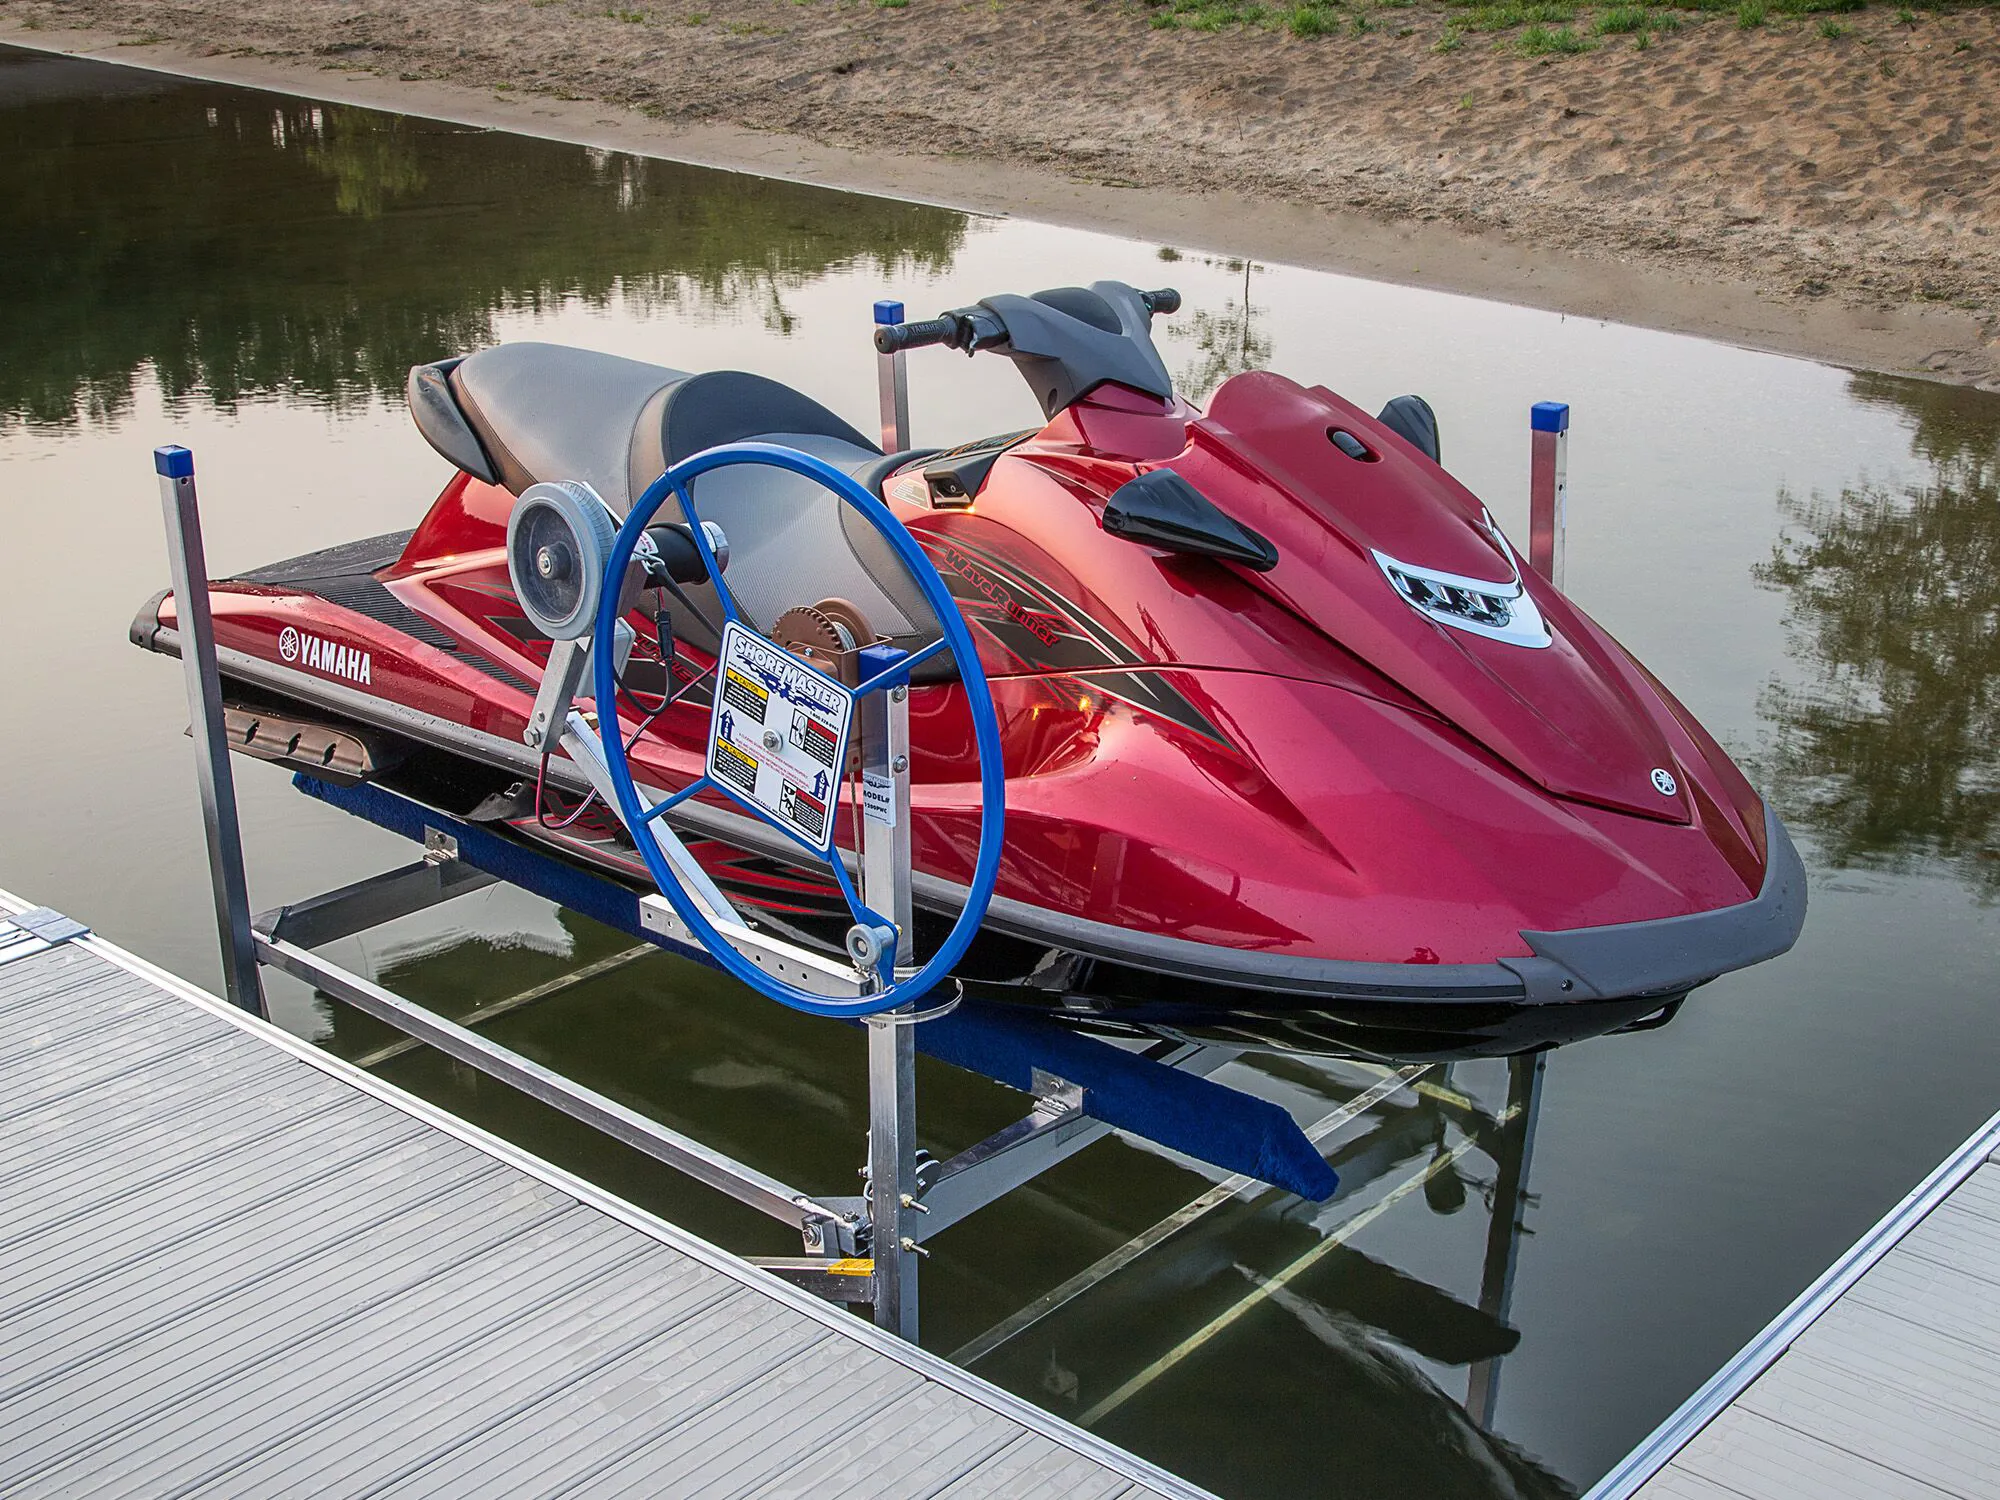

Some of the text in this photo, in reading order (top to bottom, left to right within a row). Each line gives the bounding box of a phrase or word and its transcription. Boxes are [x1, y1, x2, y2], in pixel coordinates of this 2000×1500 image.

[910, 323, 940, 335] YAMAHA
[944, 547, 1059, 647] WaveRunner
[301, 633, 371, 685] YAMAHA
[734, 636, 841, 713] SHOREMASTER
[738, 677, 759, 693] CAUTION
[729, 746, 748, 763] CAUTION
[818, 771, 826, 799] LOWER
